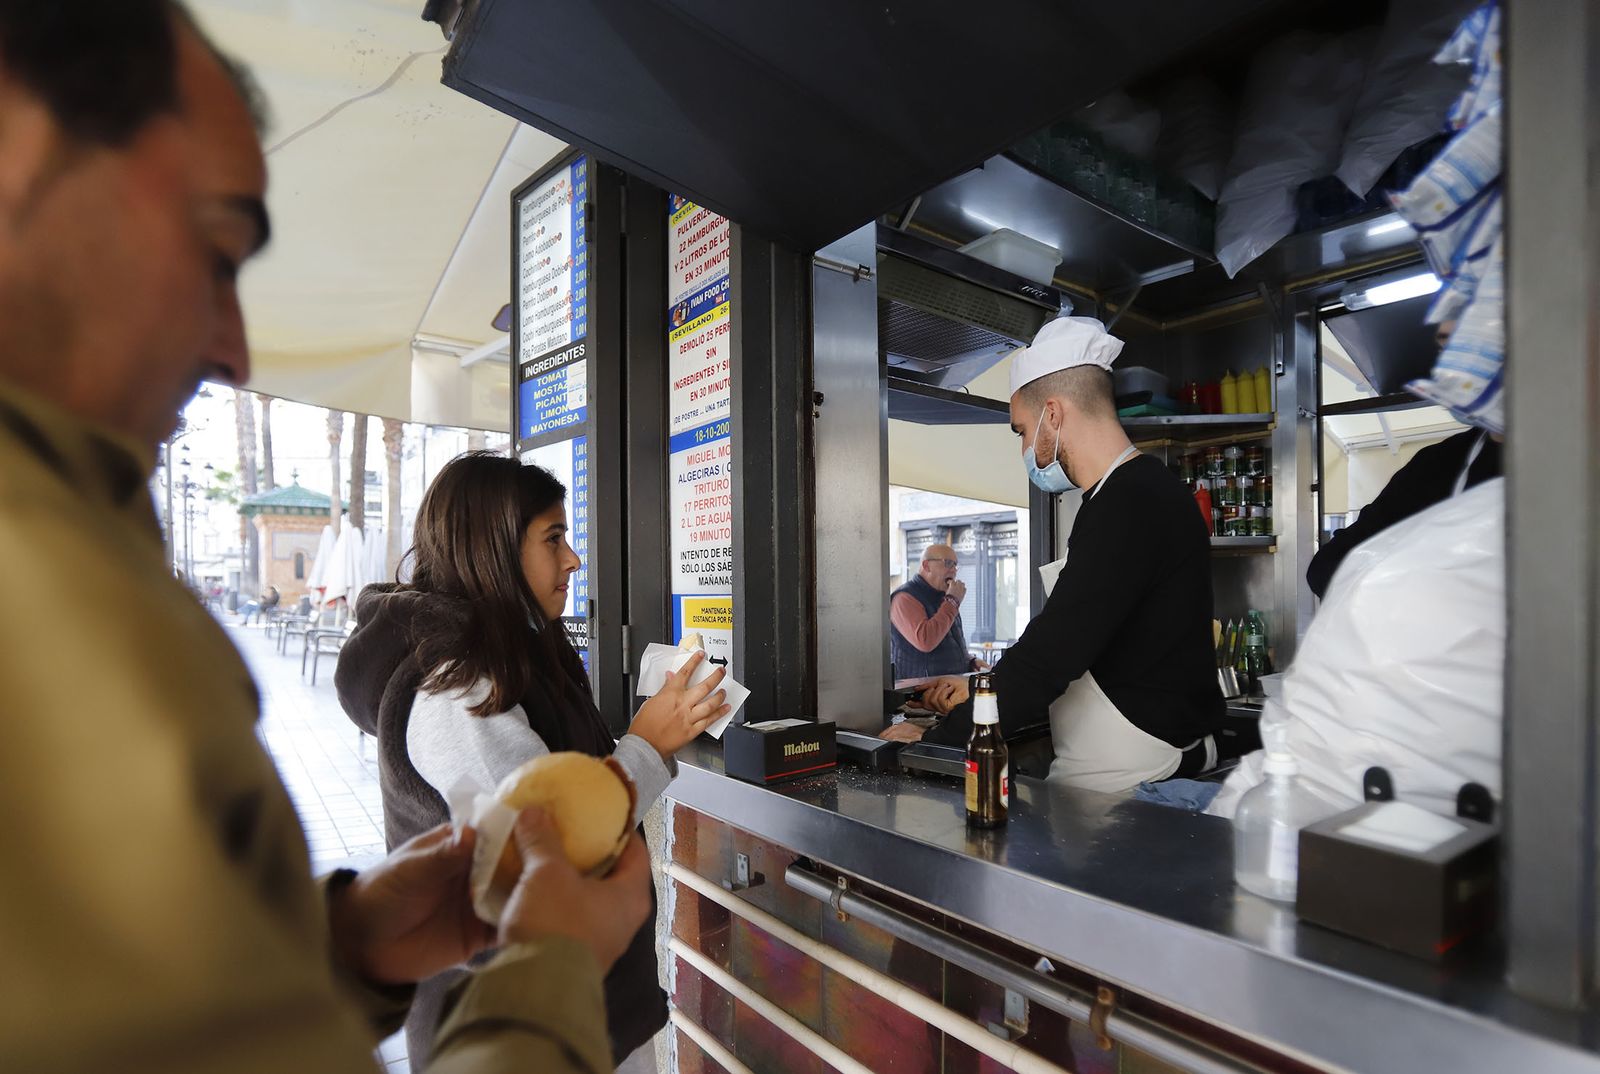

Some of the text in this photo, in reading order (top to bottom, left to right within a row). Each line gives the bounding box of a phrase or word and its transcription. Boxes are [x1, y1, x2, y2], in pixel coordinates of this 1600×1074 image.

[523, 190, 550, 214] Hamburguesa
[523, 206, 550, 230] Hamburguesa
[558, 192, 567, 208] Poll
[674, 264, 679, 272] Y
[680, 260, 684, 270] 2
[685, 244, 707, 266] LITROS
[709, 236, 718, 250] DE
[679, 241, 686, 253] 22
[523, 273, 550, 294] Hamburguesa
[685, 269, 693, 284] EN
[695, 265, 702, 277] 33
[691, 294, 703, 308] IVAN
[705, 285, 719, 301] FOOD
[672, 313, 714, 341] (SEVILLANO)
[706, 330, 714, 341] 25
[525, 344, 585, 378] INGREDIENTES
[706, 346, 716, 359] SIN
[674, 365, 715, 391] INGREDIENTES
[716, 362, 721, 373] Y
[690, 390, 698, 401] EN
[700, 387, 707, 398] 30
[541, 404, 568, 420] LIMON
[682, 409, 699, 420] POSTRE
[705, 404, 715, 413] UNA
[717, 398, 730, 408] TART
[530, 413, 580, 434] MAYONESA
[695, 422, 730, 442] 18-10-200
[687, 449, 716, 466] MIGUEL
[678, 464, 720, 484] ALGECIRAS
[694, 475, 729, 495] TRITURÓ
[684, 502, 691, 512] 17
[681, 518, 685, 528] 2
[696, 515, 706, 526] DE
[708, 511, 731, 525] AGUA
[690, 528, 730, 542] 19 MINUTO
[680, 549, 708, 560] INTENTO
[711, 548, 720, 558] DE
[681, 562, 699, 573] SÓLO
[701, 562, 715, 572] LOS
[699, 575, 732, 586] MAÑANAS
[564, 620, 587, 633] ÍCULOS
[784, 742, 820, 756] Mahou
